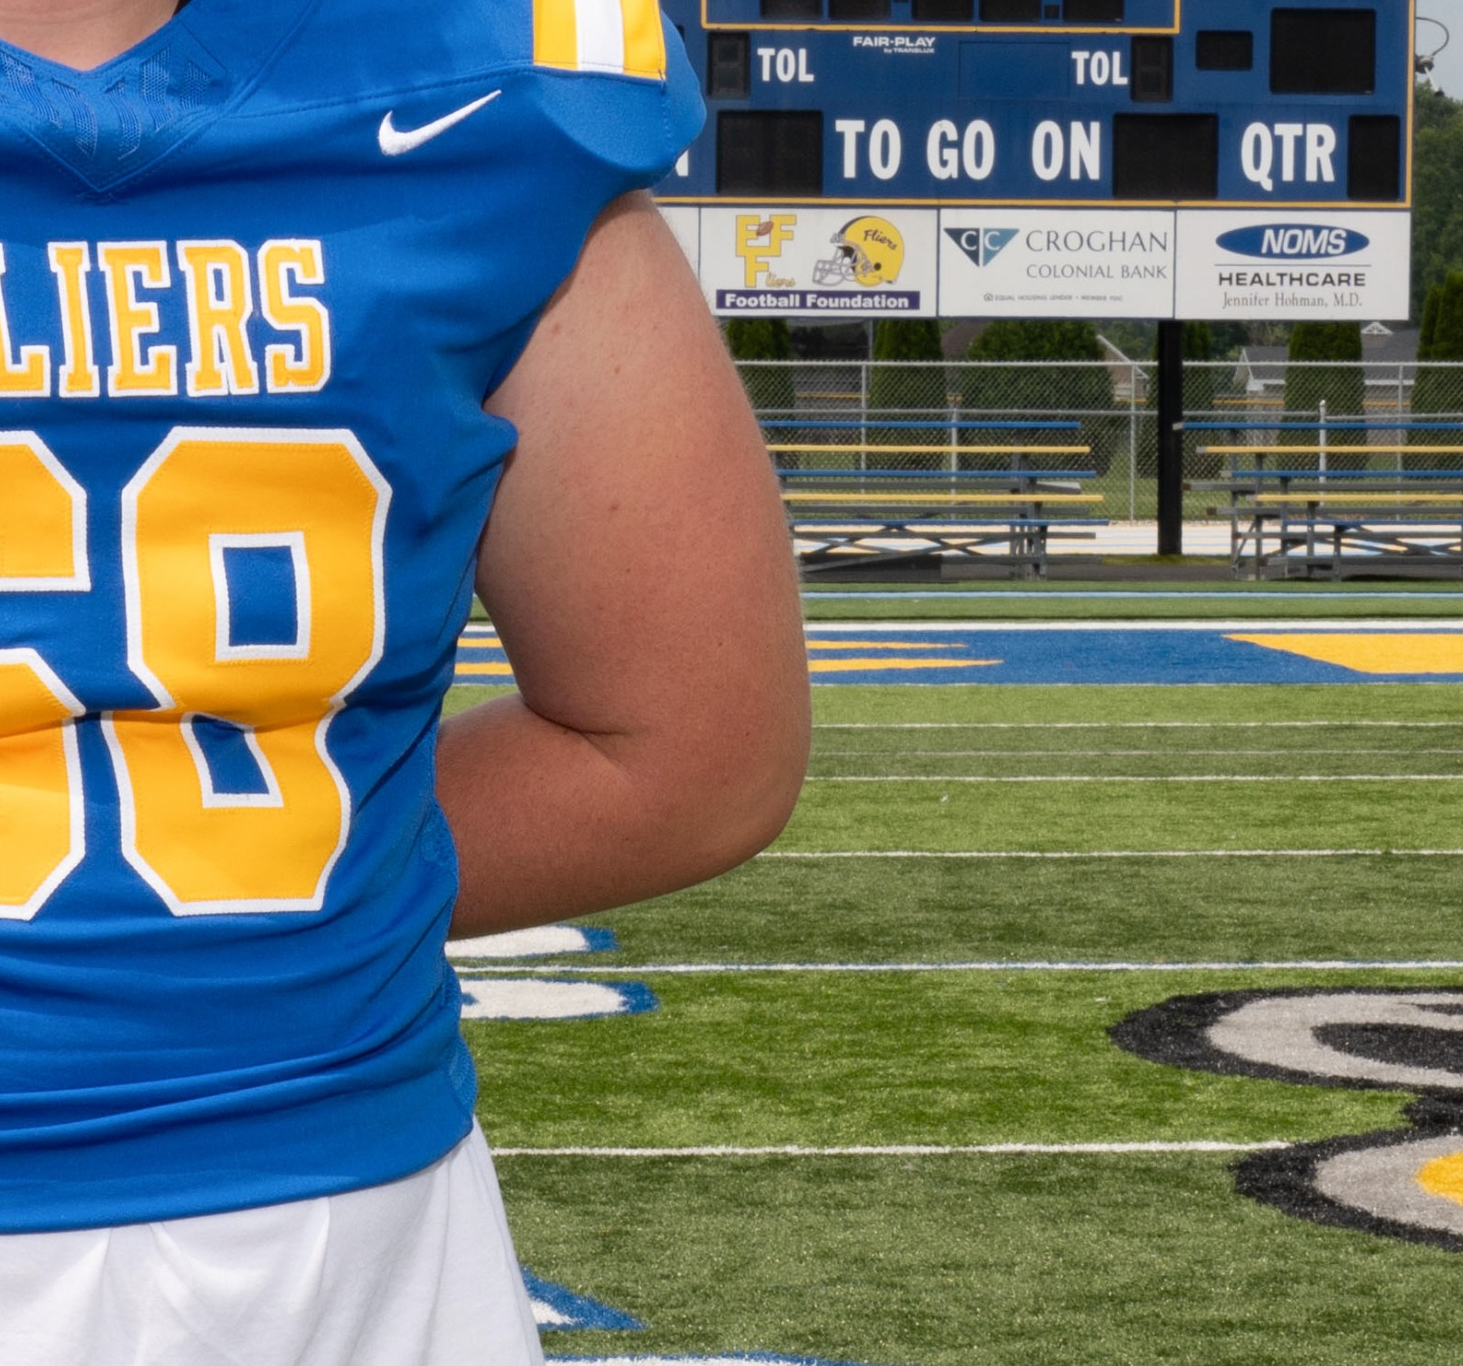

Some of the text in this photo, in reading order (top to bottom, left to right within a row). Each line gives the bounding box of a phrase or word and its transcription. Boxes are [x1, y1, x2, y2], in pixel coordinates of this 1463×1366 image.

[852, 35, 936, 48] FAIR-PLAY
[756, 47, 816, 83] TOL
[1070, 50, 1129, 86] TOL
[834, 117, 1102, 182] TO GO ON
[1240, 121, 1338, 192] QTR
[863, 228, 899, 251] Fliers
[1025, 229, 1169, 253] CROGHAN
[1260, 227, 1348, 256] NOMS
[1025, 262, 1168, 280] COLONIAL BANK
[1218, 271, 1367, 287] HEALTHCARE
[724, 292, 910, 310] Football Foundation
[1222, 291, 1363, 310] Jennifer Hohman, M.D.
